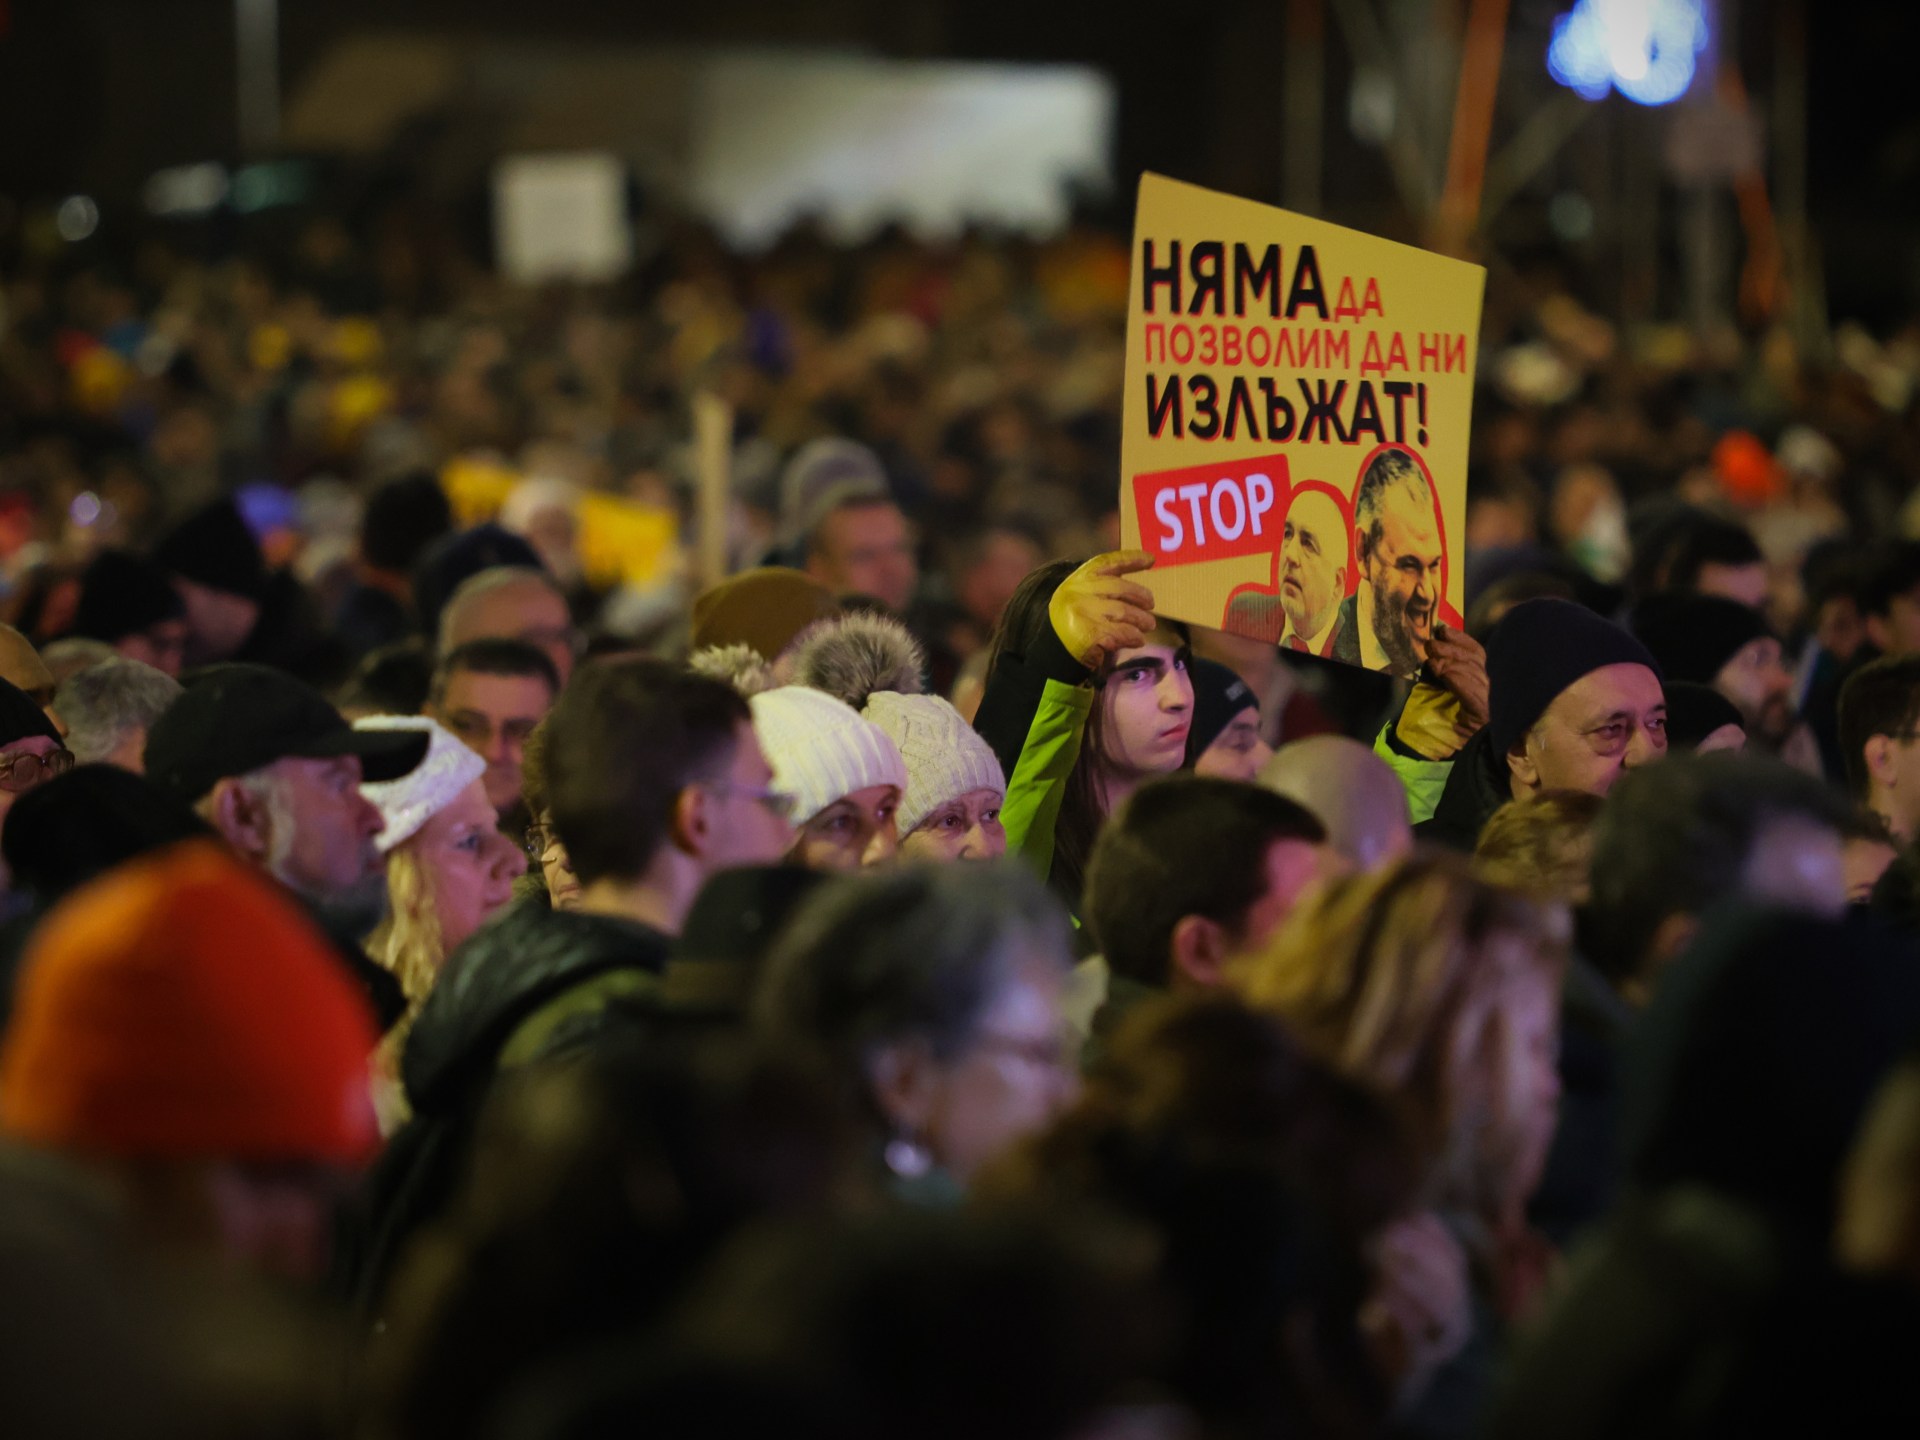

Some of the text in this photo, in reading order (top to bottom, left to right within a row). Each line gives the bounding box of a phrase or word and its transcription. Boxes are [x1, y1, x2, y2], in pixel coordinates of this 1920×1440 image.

[1143, 238, 1384, 323] НЯМА ДА
[1145, 323, 1467, 377] ПОЗВОЛИМ ДА НИ
[1145, 373, 1430, 448] ИЗЛЪЖАТ!
[1154, 473, 1274, 552] STOP
